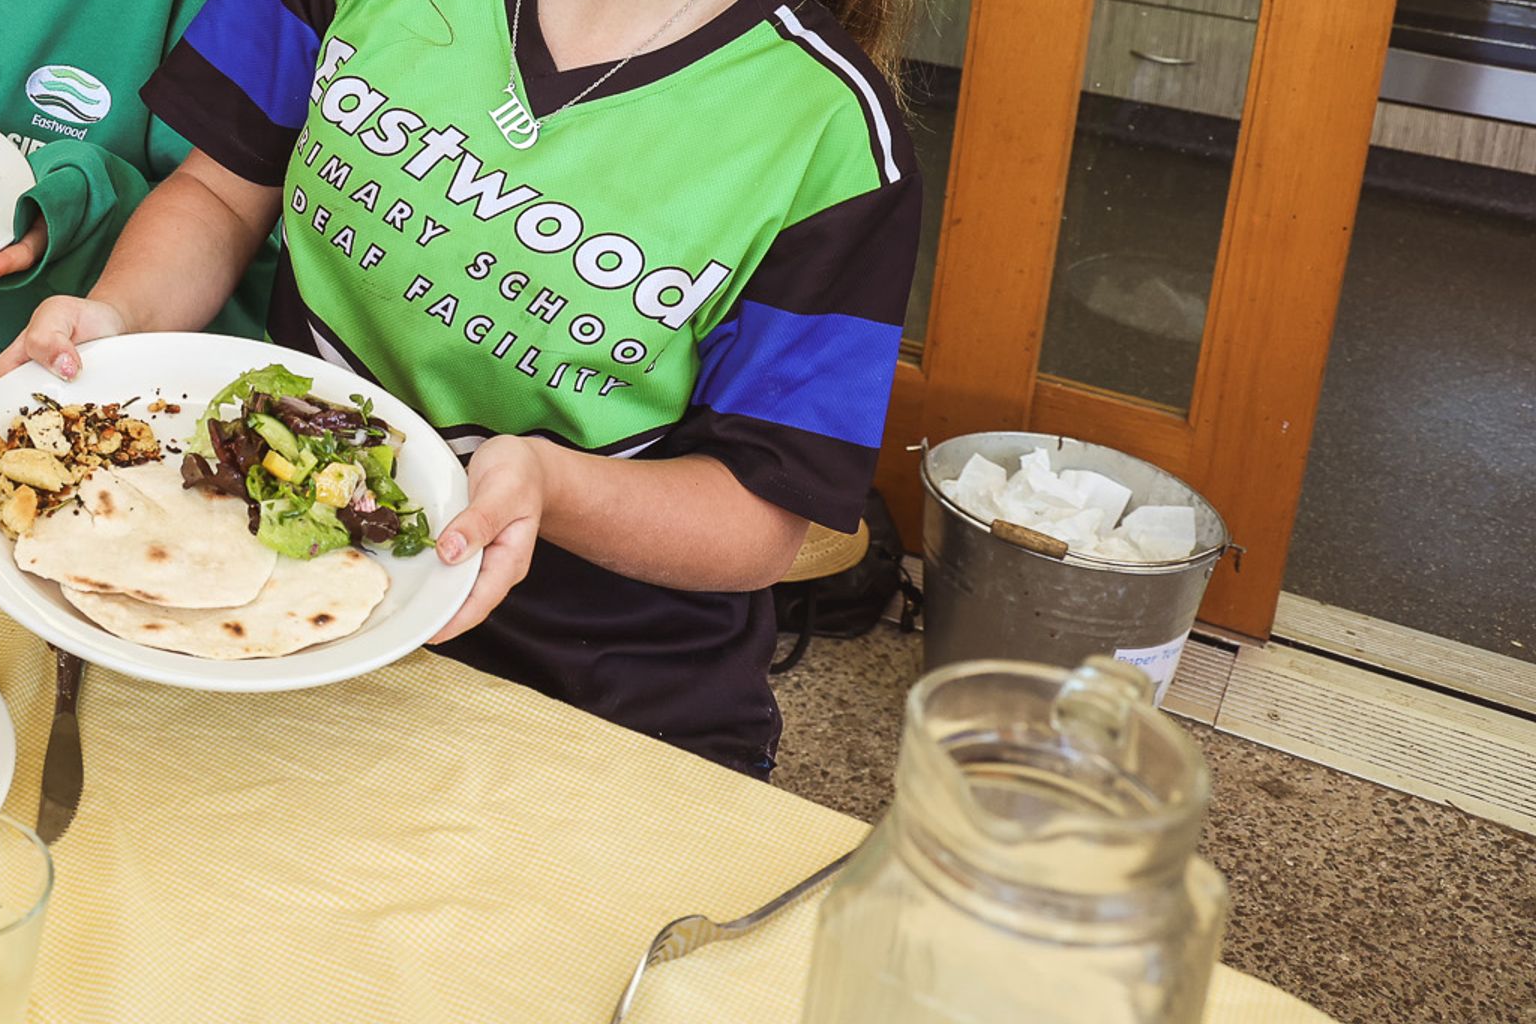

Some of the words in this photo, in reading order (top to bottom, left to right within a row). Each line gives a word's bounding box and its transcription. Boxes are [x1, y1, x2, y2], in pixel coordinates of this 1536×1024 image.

[31, 113, 88, 140] Eastwood
[310, 36, 731, 330] Eastwood
[291, 184, 386, 270] DEAF
[403, 274, 632, 396] FACILITY
[297, 126, 450, 247] RIMARY
[465, 252, 656, 373] SCHOO
